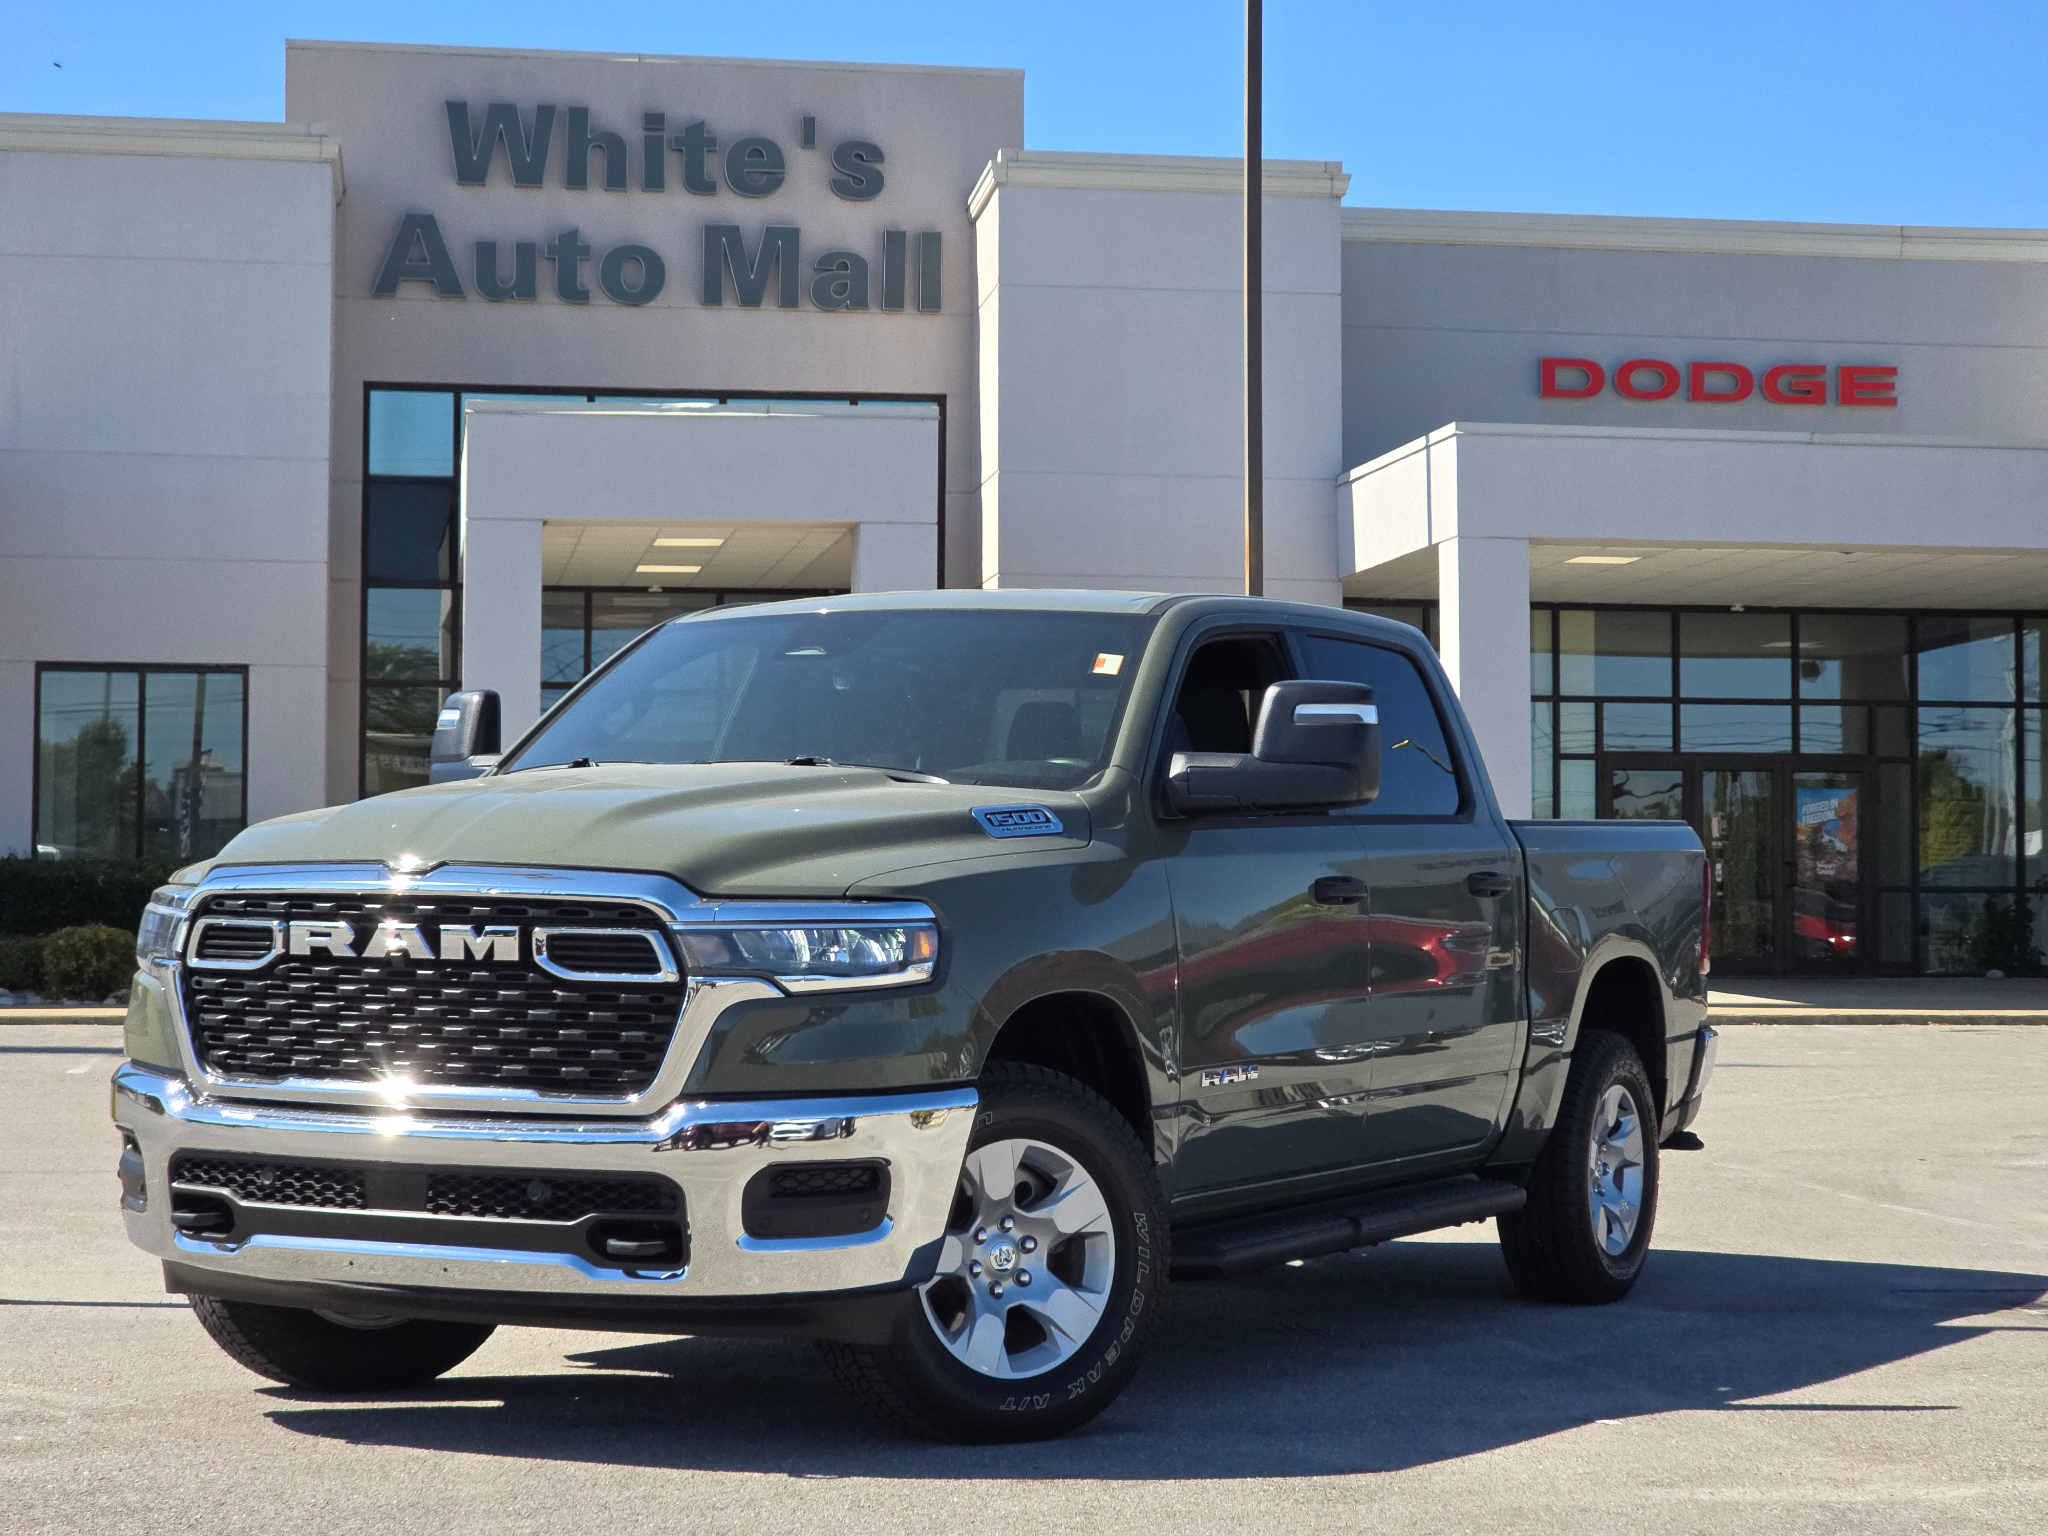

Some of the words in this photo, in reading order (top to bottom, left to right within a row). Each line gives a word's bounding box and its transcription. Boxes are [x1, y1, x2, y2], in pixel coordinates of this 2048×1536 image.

[446, 100, 885, 200] White's
[371, 213, 666, 305] Auto
[701, 223, 943, 313] Mall
[1539, 357, 1898, 406] DODGE
[987, 811, 1047, 826] 1500
[1802, 800, 1829, 815] FORGED
[1830, 798, 1839, 809] IN
[1001, 824, 1053, 832] HURRICANE
[289, 920, 520, 961] RAM
[1201, 1064, 1259, 1087] RAM
[1066, 1212, 1151, 1399] WILDPEAK
[999, 1393, 1050, 1411] A/T
